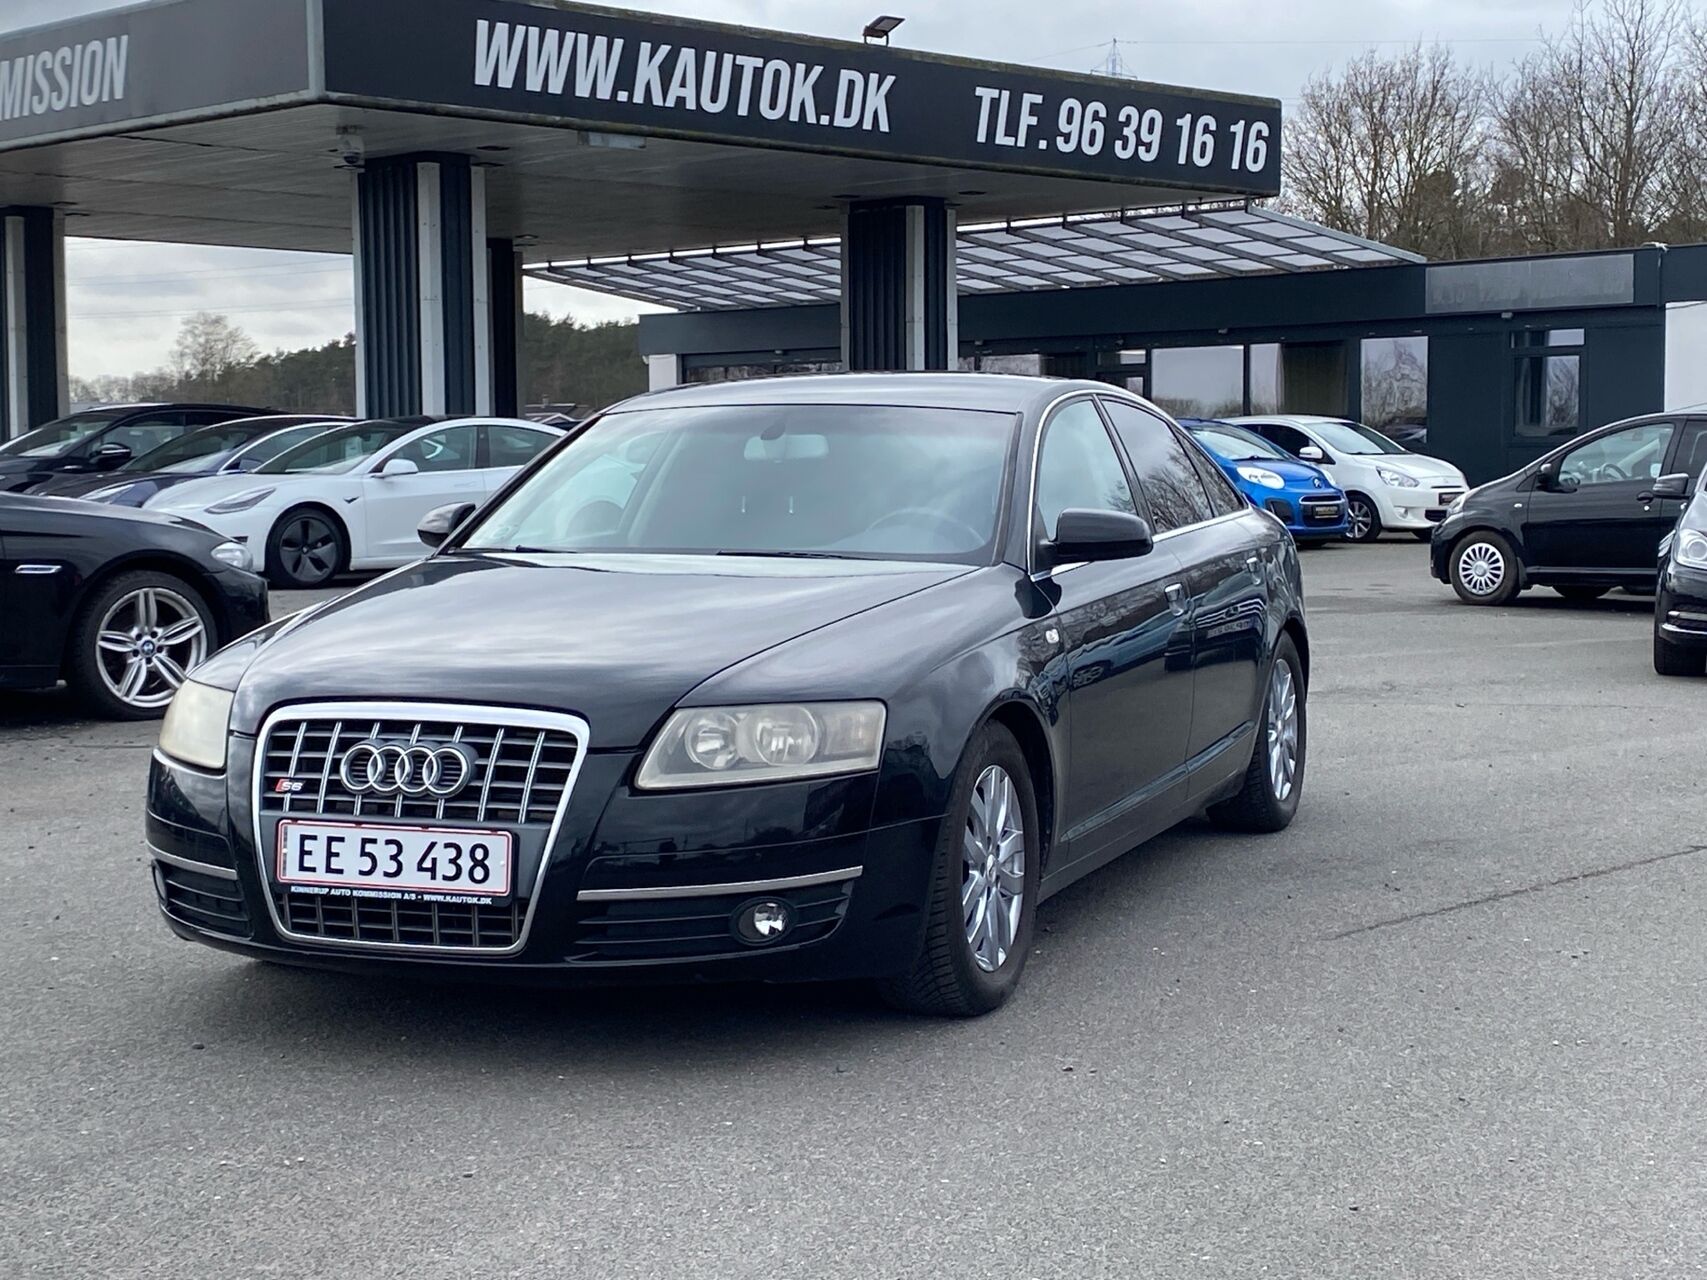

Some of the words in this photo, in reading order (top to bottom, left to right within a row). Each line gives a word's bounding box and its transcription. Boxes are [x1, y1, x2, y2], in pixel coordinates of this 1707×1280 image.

[474, 19, 897, 133] WWW.KAUTOK.DK
[975, 87, 1048, 150] TLF.
[1056, 98, 1107, 155] 96
[1114, 106, 1163, 162] 39
[1176, 113, 1217, 167] 16
[1230, 119, 1270, 173] 16
[280, 781, 303, 791] S6
[298, 834, 345, 875] EE
[358, 837, 403, 878] 53
[416, 841, 490, 884] 438
[330, 888, 351, 896] AUTO
[352, 889, 401, 899] KOMMISSION
[403, 892, 416, 900] A/S
[423, 893, 492, 904] WWW.KAUTOK.DK
